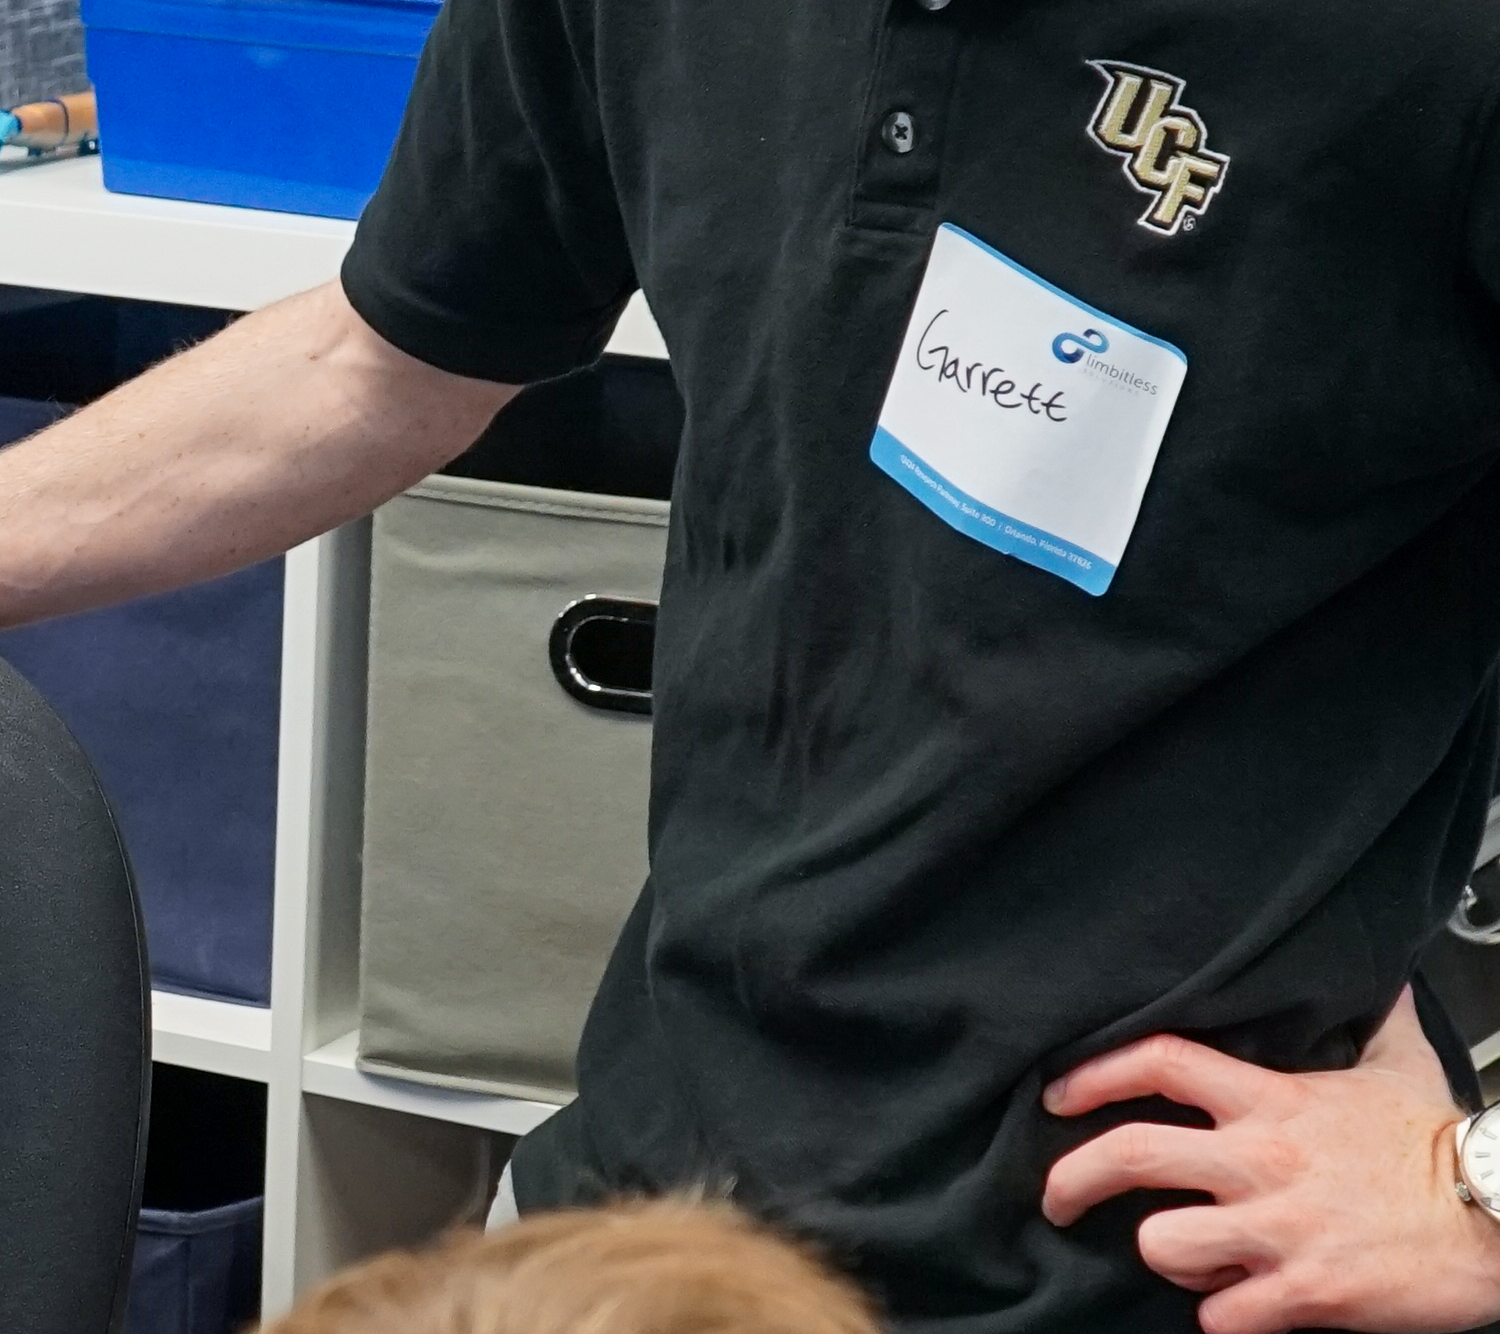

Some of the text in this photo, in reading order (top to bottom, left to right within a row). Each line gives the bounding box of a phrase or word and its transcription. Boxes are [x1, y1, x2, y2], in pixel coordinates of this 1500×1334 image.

[1092, 64, 1228, 230] UCF
[916, 308, 1068, 422] Garrett
[1085, 353, 1159, 396] limbitless
